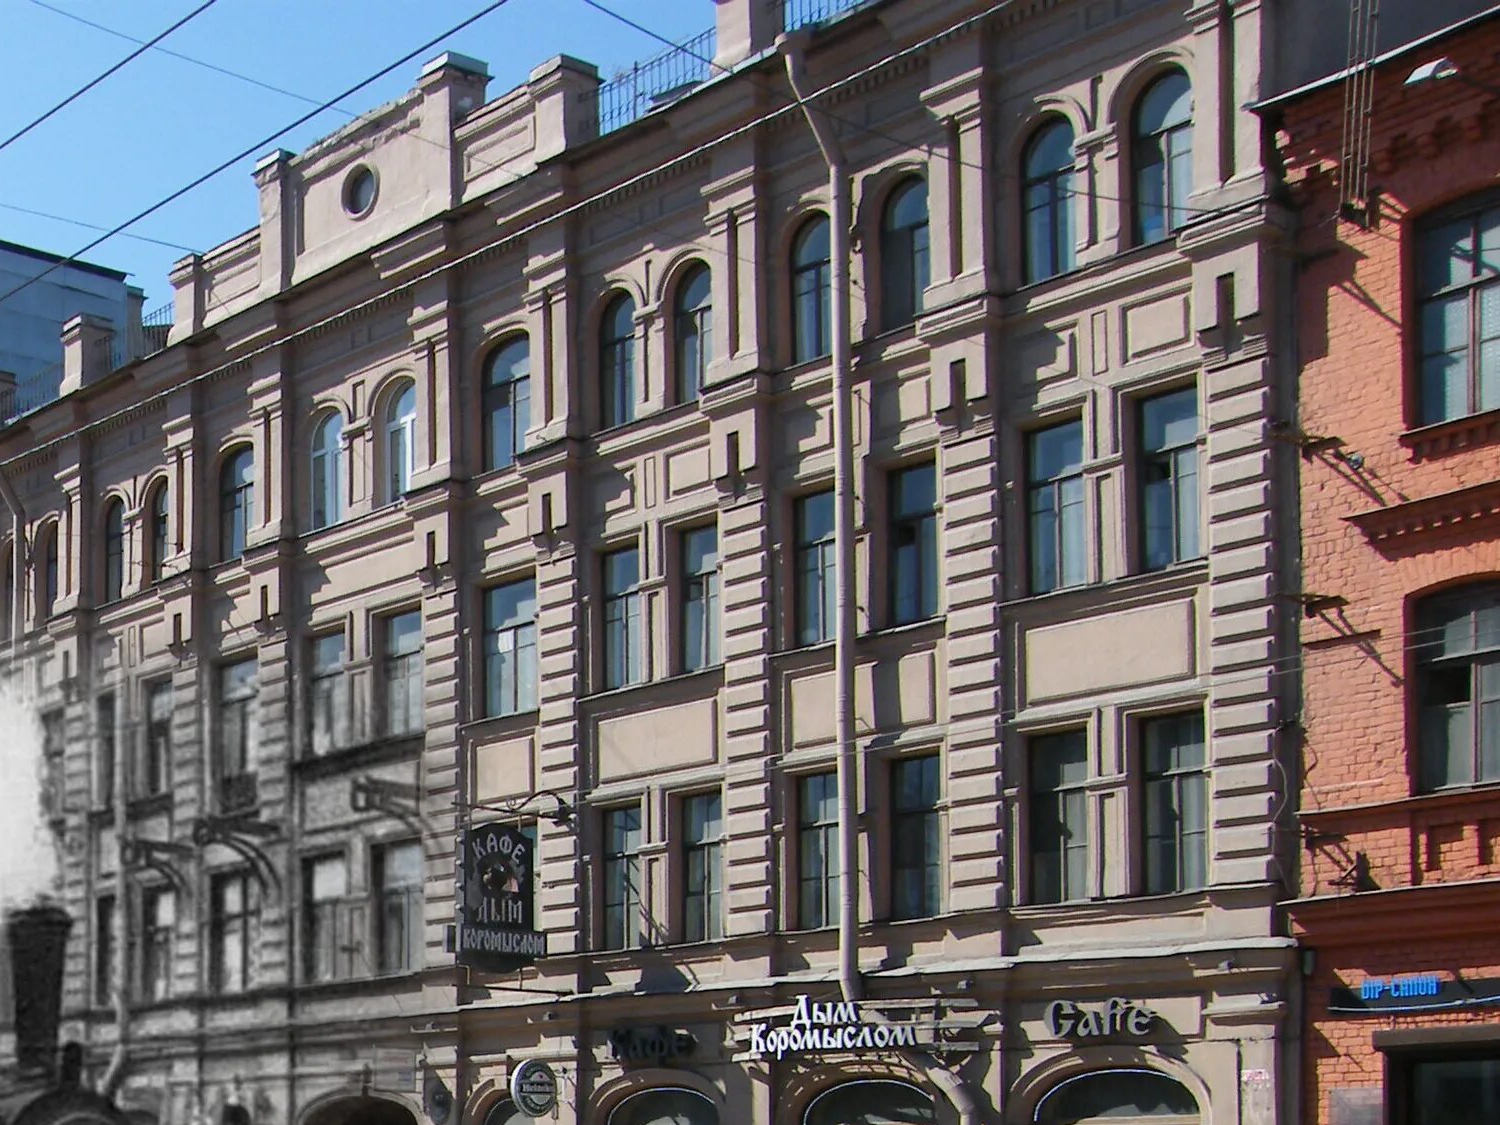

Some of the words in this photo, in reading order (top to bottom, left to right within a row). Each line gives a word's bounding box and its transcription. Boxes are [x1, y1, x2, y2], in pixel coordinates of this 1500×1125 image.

[471, 832, 526, 863] КАФЕ
[476, 896, 523, 924] ДЫМ
[462, 928, 545, 955] КОРОМЫСЛОМ
[790, 994, 859, 1030] Дым
[750, 1023, 917, 1061] Коромыслом
